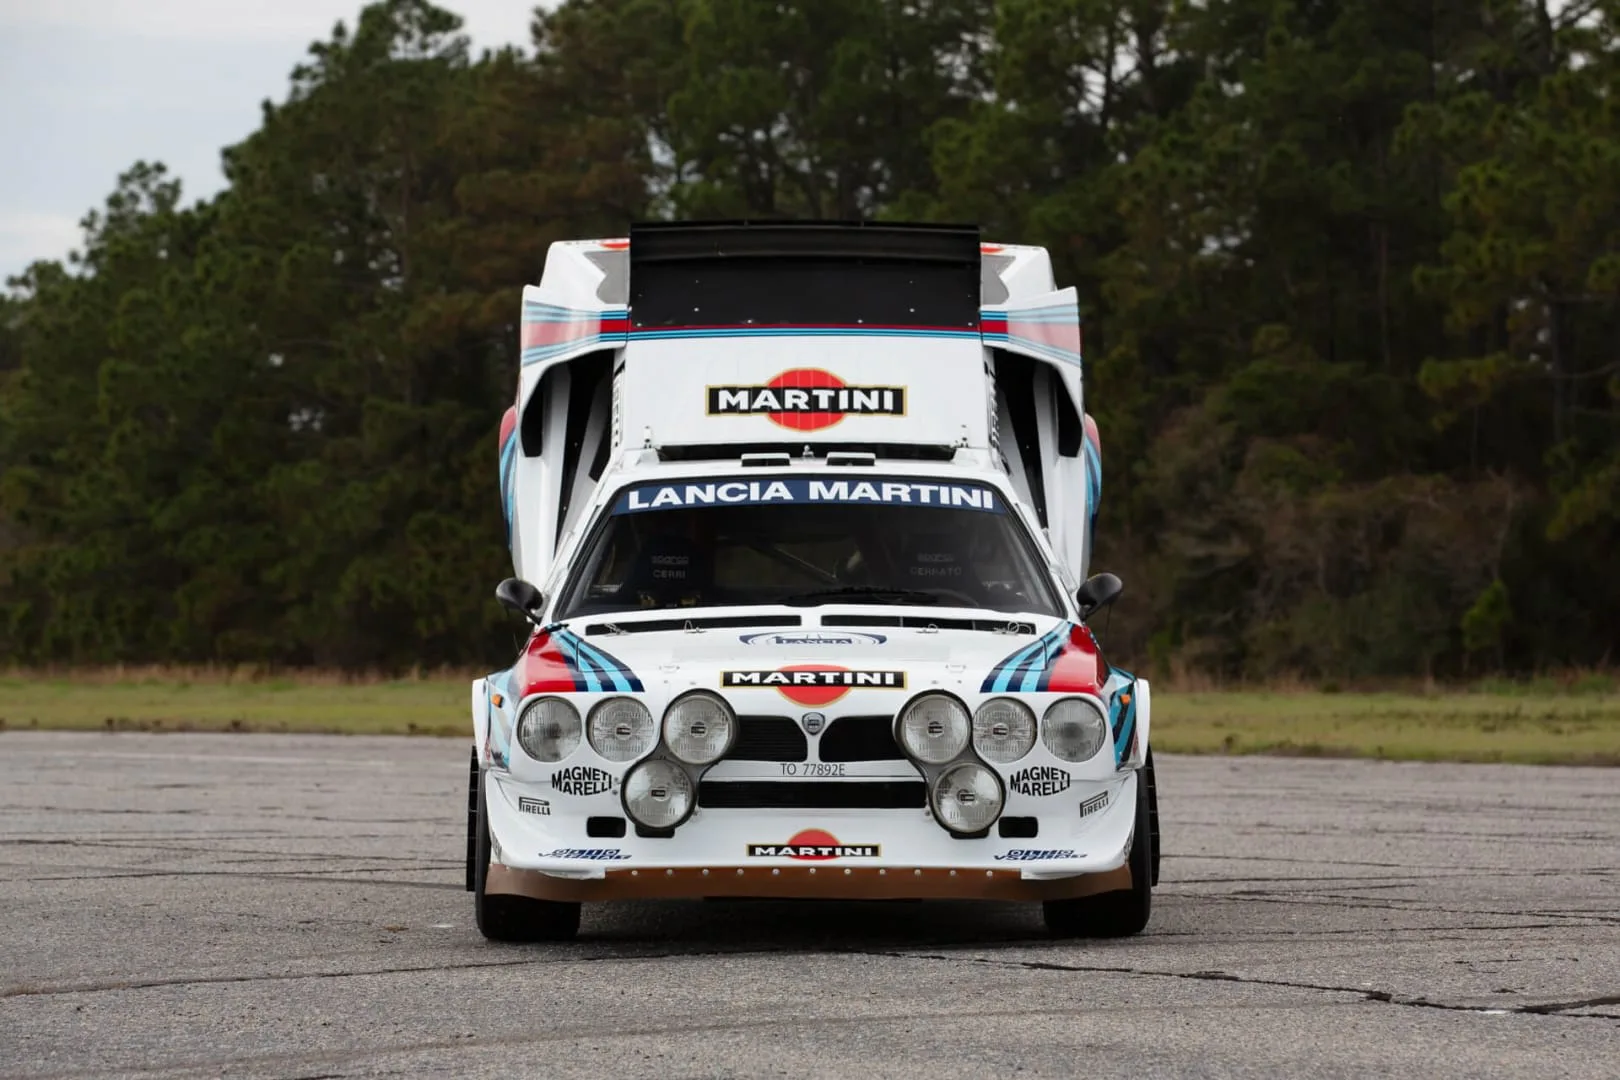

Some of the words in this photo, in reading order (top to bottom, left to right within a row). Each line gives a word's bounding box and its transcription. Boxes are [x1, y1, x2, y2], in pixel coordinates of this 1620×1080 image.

[718, 389, 894, 411] MARTINI
[628, 481, 794, 510] LANCIA
[808, 481, 994, 509] MARTINI
[731, 671, 895, 685] MARTINI
[551, 766, 612, 786] MAGNETI
[780, 763, 797, 776] TO
[802, 763, 846, 776] 77892E
[1009, 766, 1071, 786] MAGNETI
[519, 796, 551, 815] PIRELLI
[1079, 790, 1109, 818] PIRELLI
[755, 847, 872, 856] MARTINI
